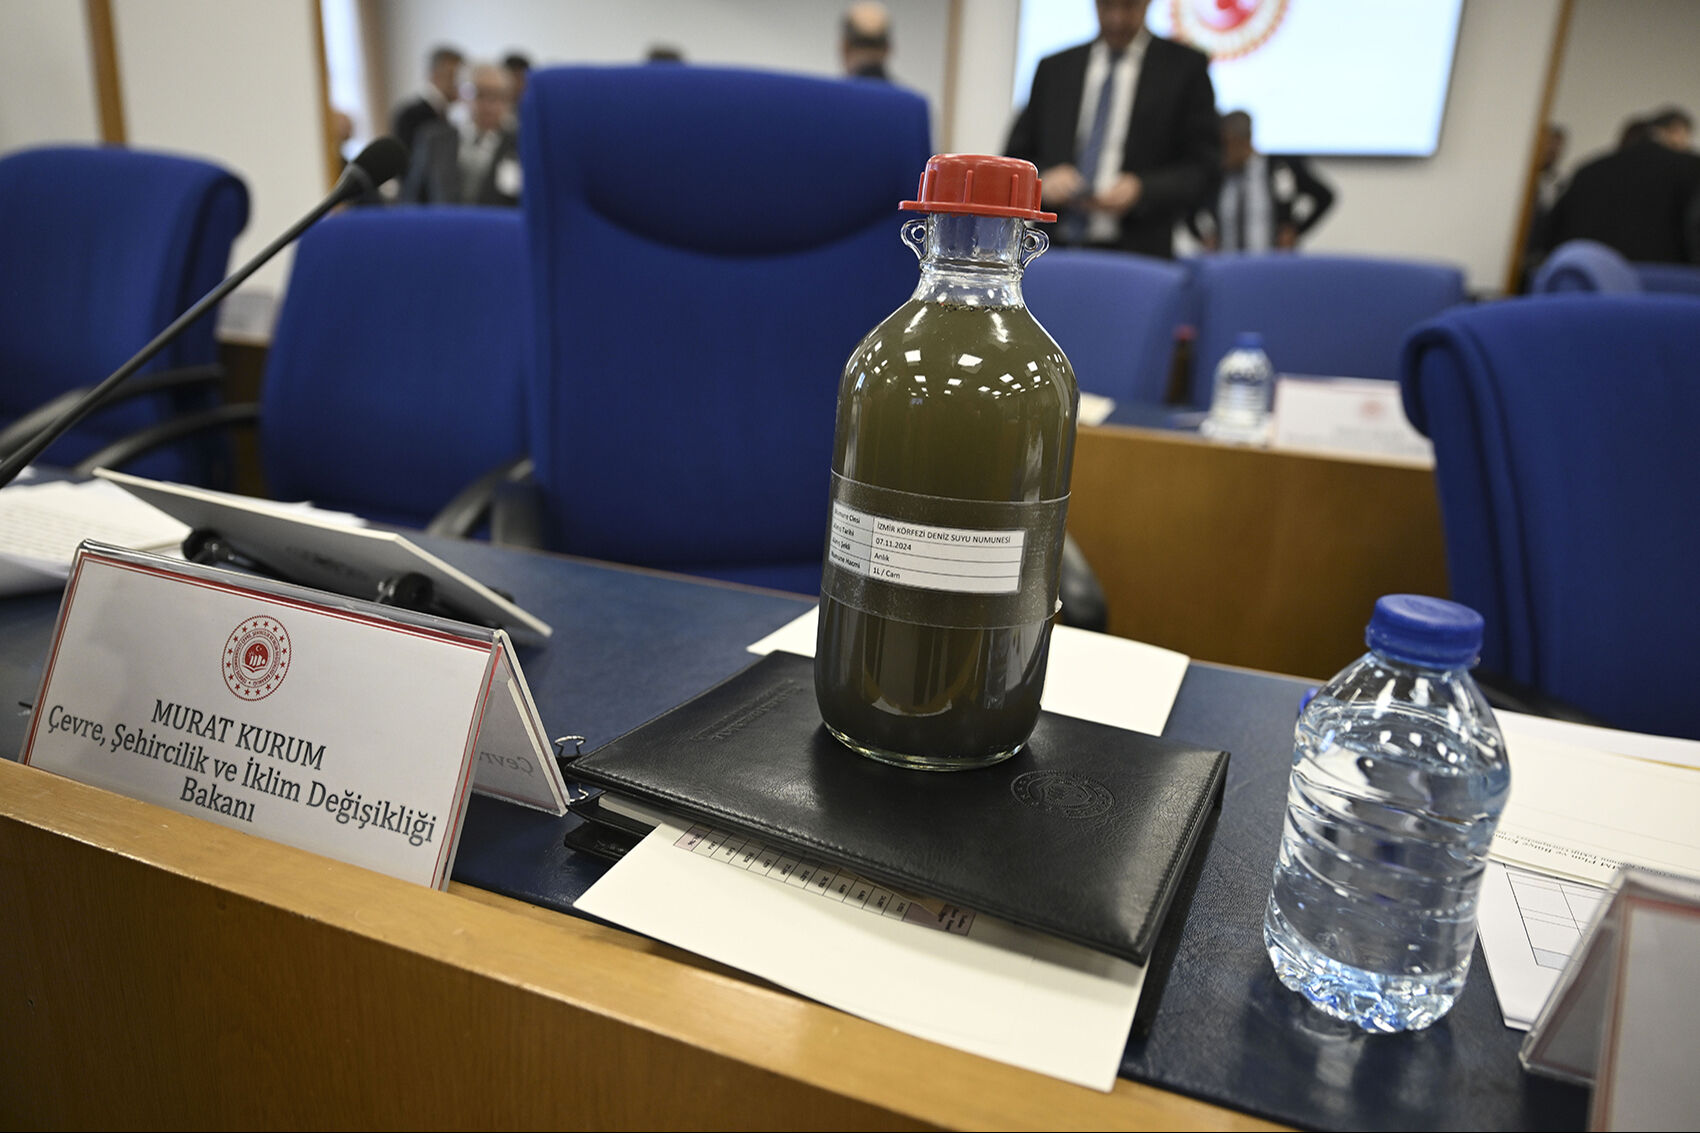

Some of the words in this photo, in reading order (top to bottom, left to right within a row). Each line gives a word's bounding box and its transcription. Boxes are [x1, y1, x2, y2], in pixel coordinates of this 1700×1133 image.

[875, 537, 912, 551] 07.11.2024
[877, 521, 896, 533] İZMİR
[896, 526, 926, 539] KÖRFEZİ
[927, 531, 950, 541] DENİZ
[951, 534, 971, 543] SUYU
[972, 536, 1012, 544] NUMUNESİ
[874, 552, 890, 562] Anlık
[873, 567, 881, 575] 1L
[881, 568, 886, 576] /
[885, 569, 901, 579] Cam
[151, 699, 235, 743] MURAT
[235, 722, 327, 771] KURUM
[48, 704, 106, 747] Çevre,
[111, 723, 210, 774] Şehircilik
[213, 758, 238, 782] ve
[241, 756, 301, 803] İklim
[306, 780, 437, 847] Değişikliği
[179, 776, 256, 823] Bakanı
